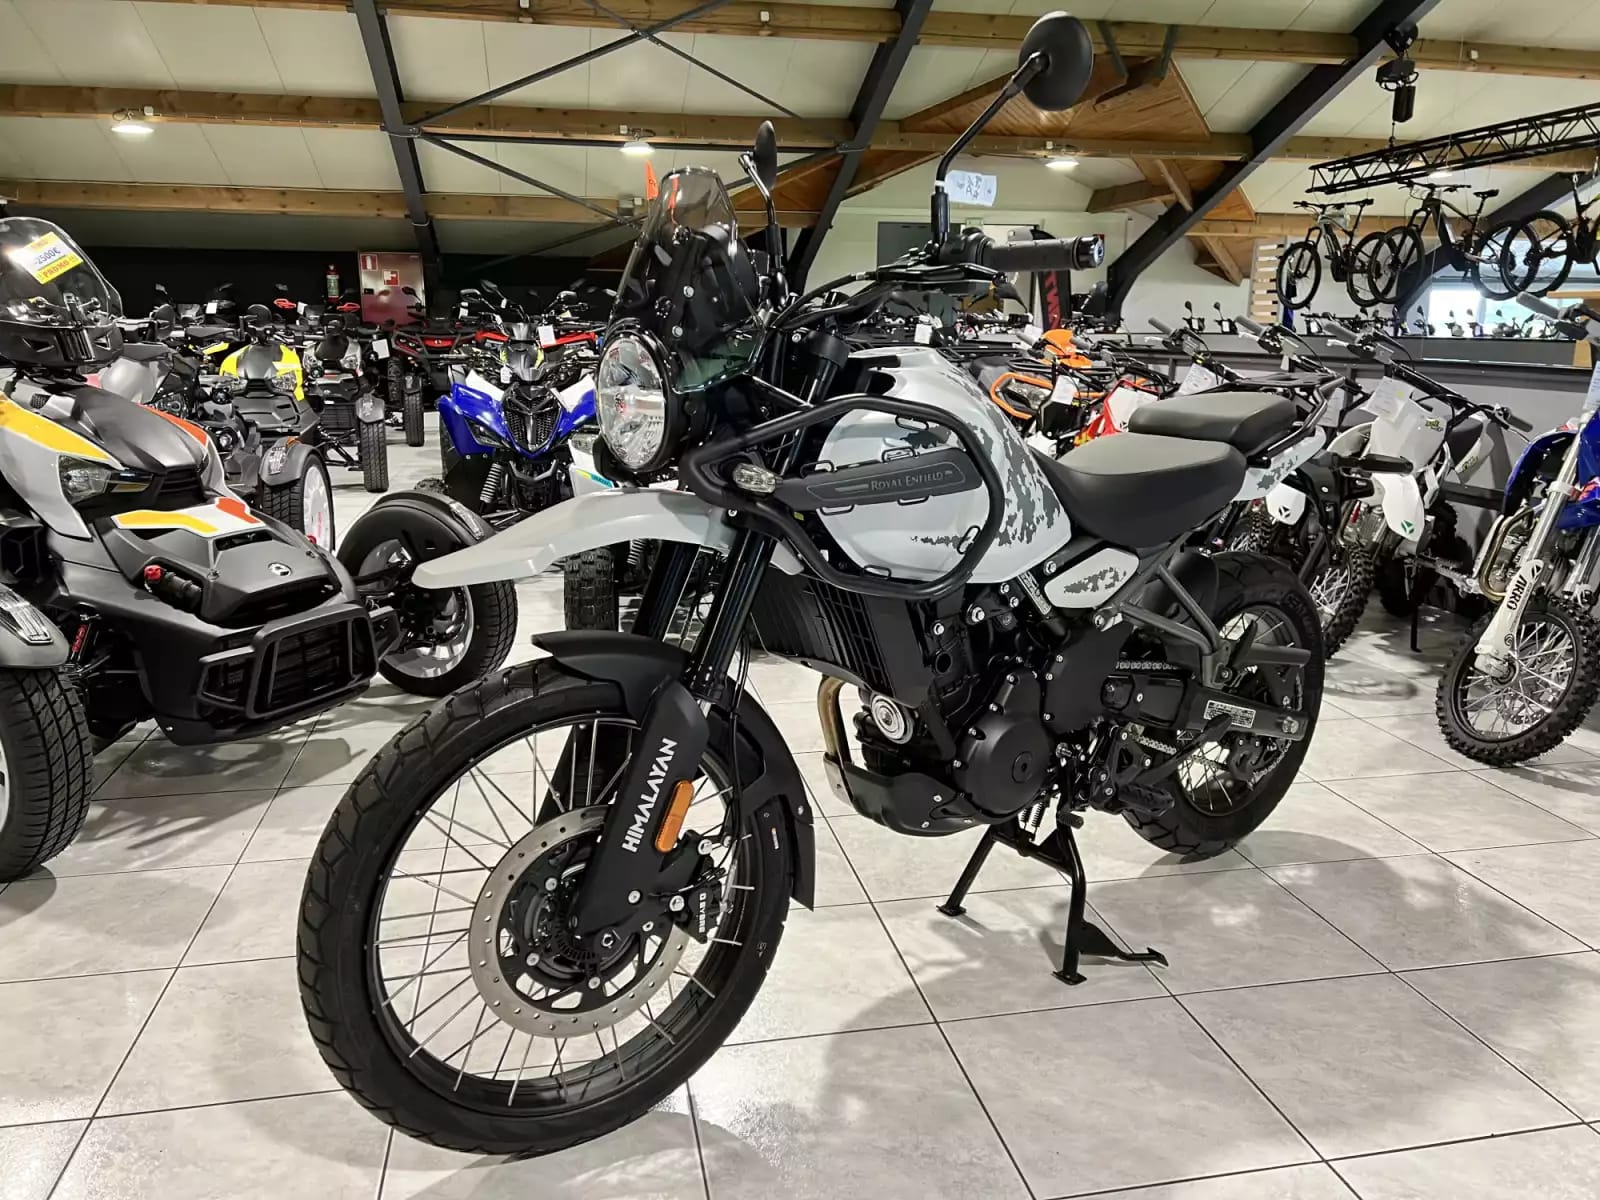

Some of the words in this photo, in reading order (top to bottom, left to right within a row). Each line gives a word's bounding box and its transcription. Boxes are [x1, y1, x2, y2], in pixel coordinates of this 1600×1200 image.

[871, 479, 902, 491] ROYAL
[905, 472, 944, 487] ENFIELD
[622, 738, 678, 853] HIMALAYAN
